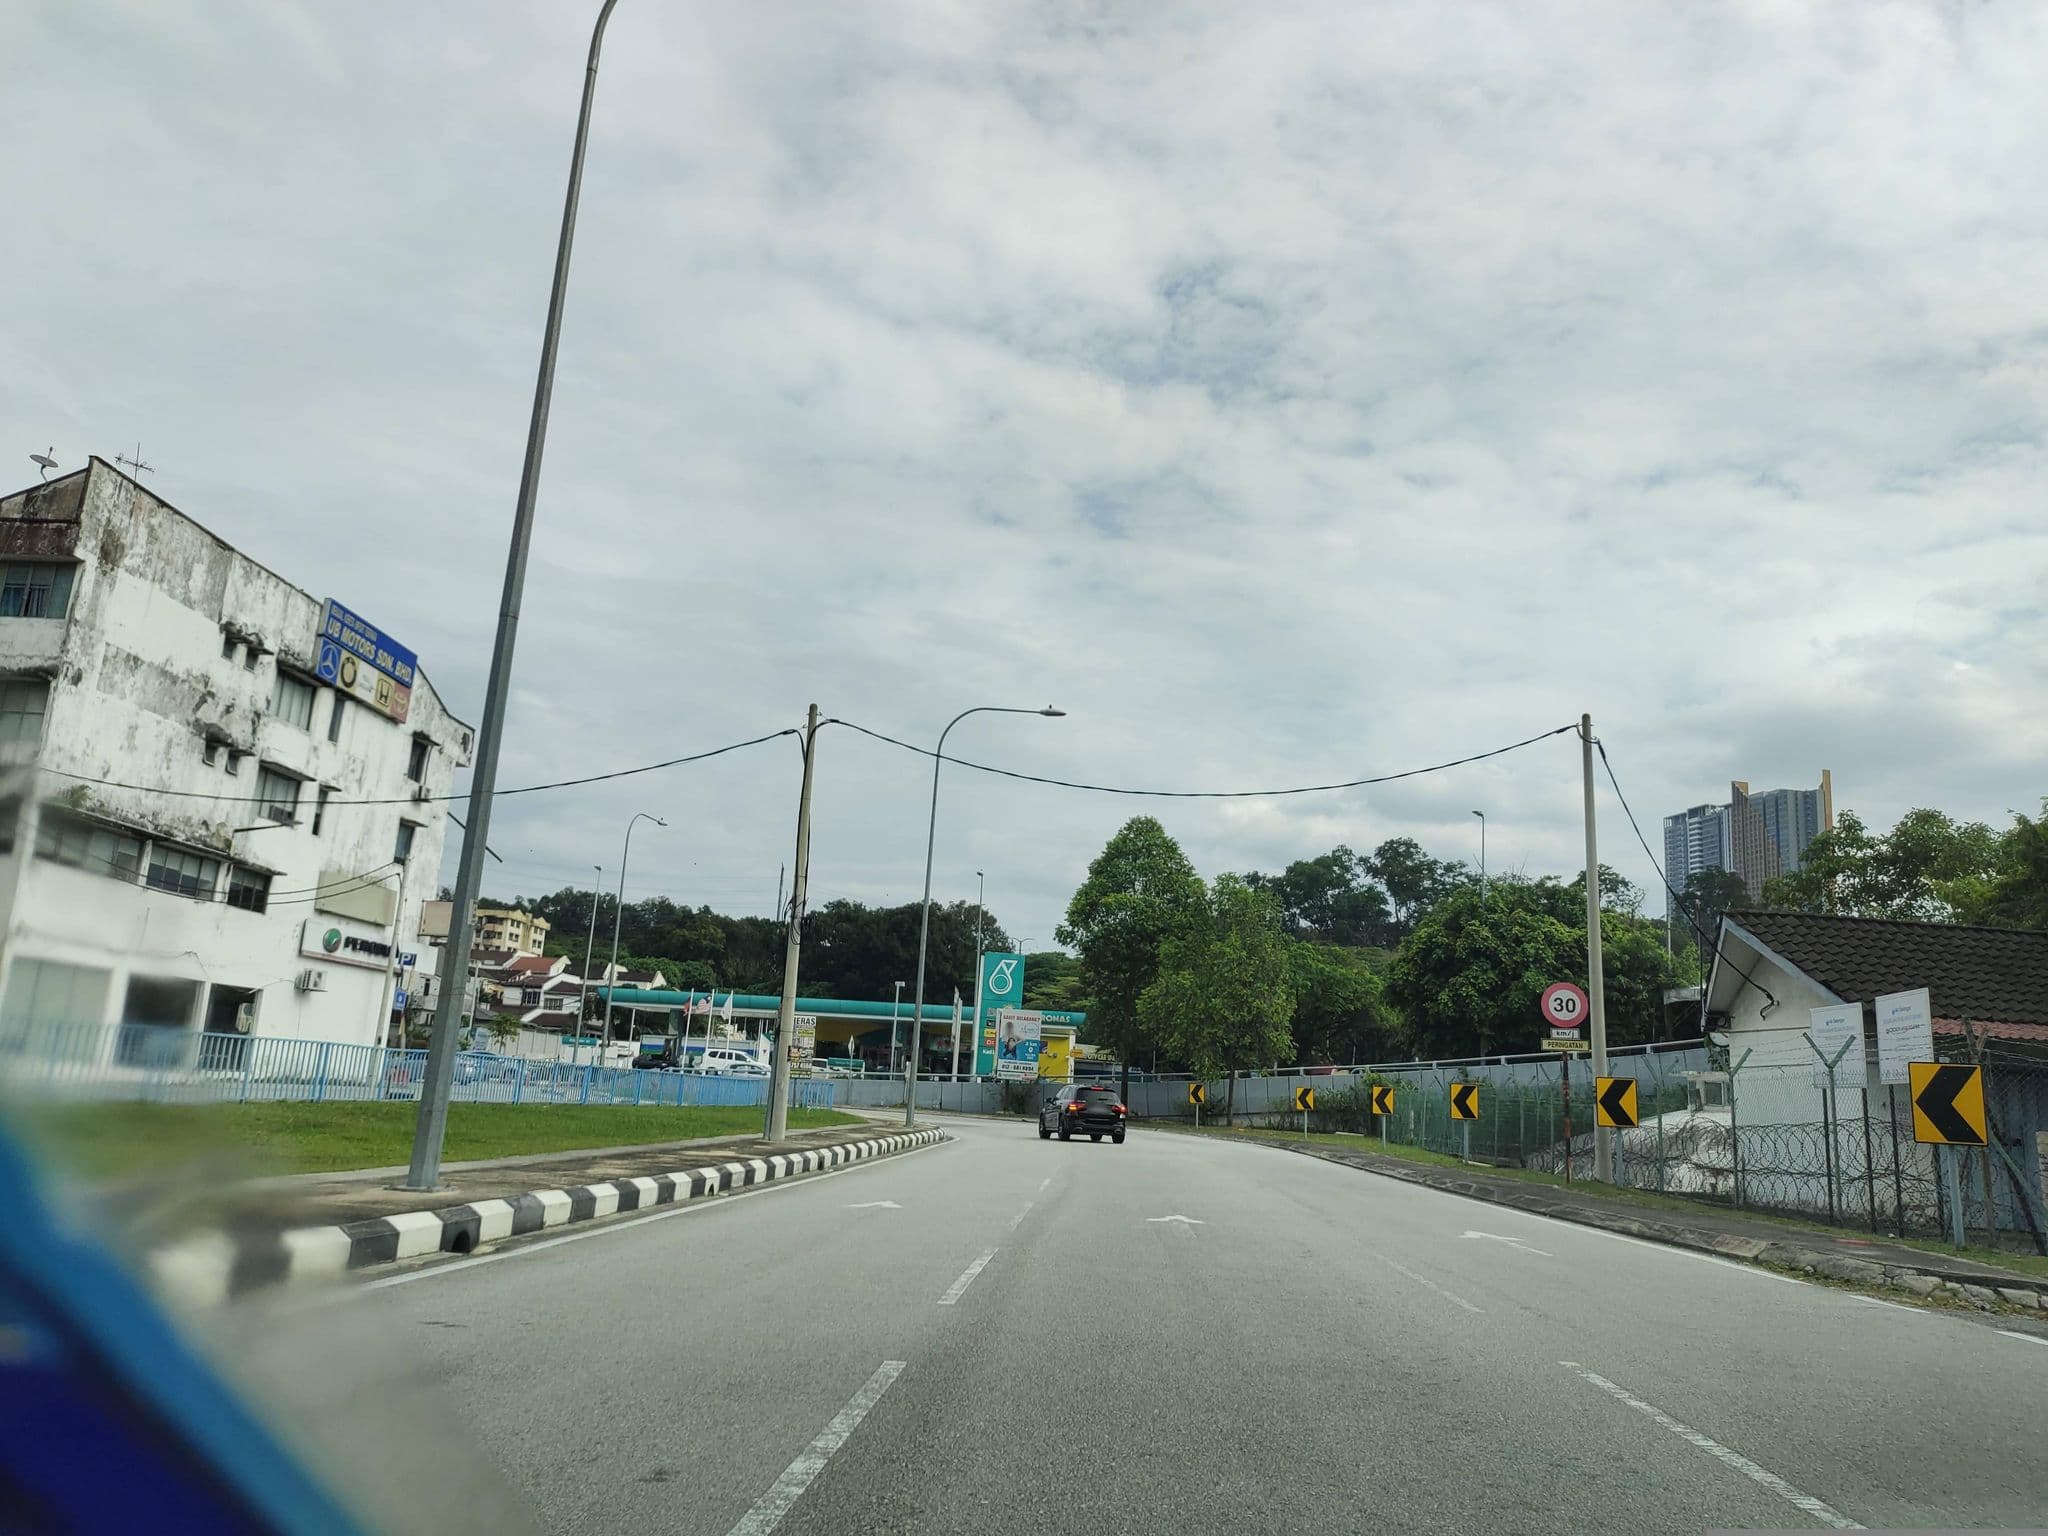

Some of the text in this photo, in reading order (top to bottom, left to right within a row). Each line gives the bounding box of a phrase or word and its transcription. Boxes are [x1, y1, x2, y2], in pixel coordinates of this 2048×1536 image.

[327, 617, 342, 638] UB
[341, 626, 377, 660] MOTORS
[1553, 997, 1576, 1013] 30
[1547, 1041, 1584, 1049] PERINGATAN
